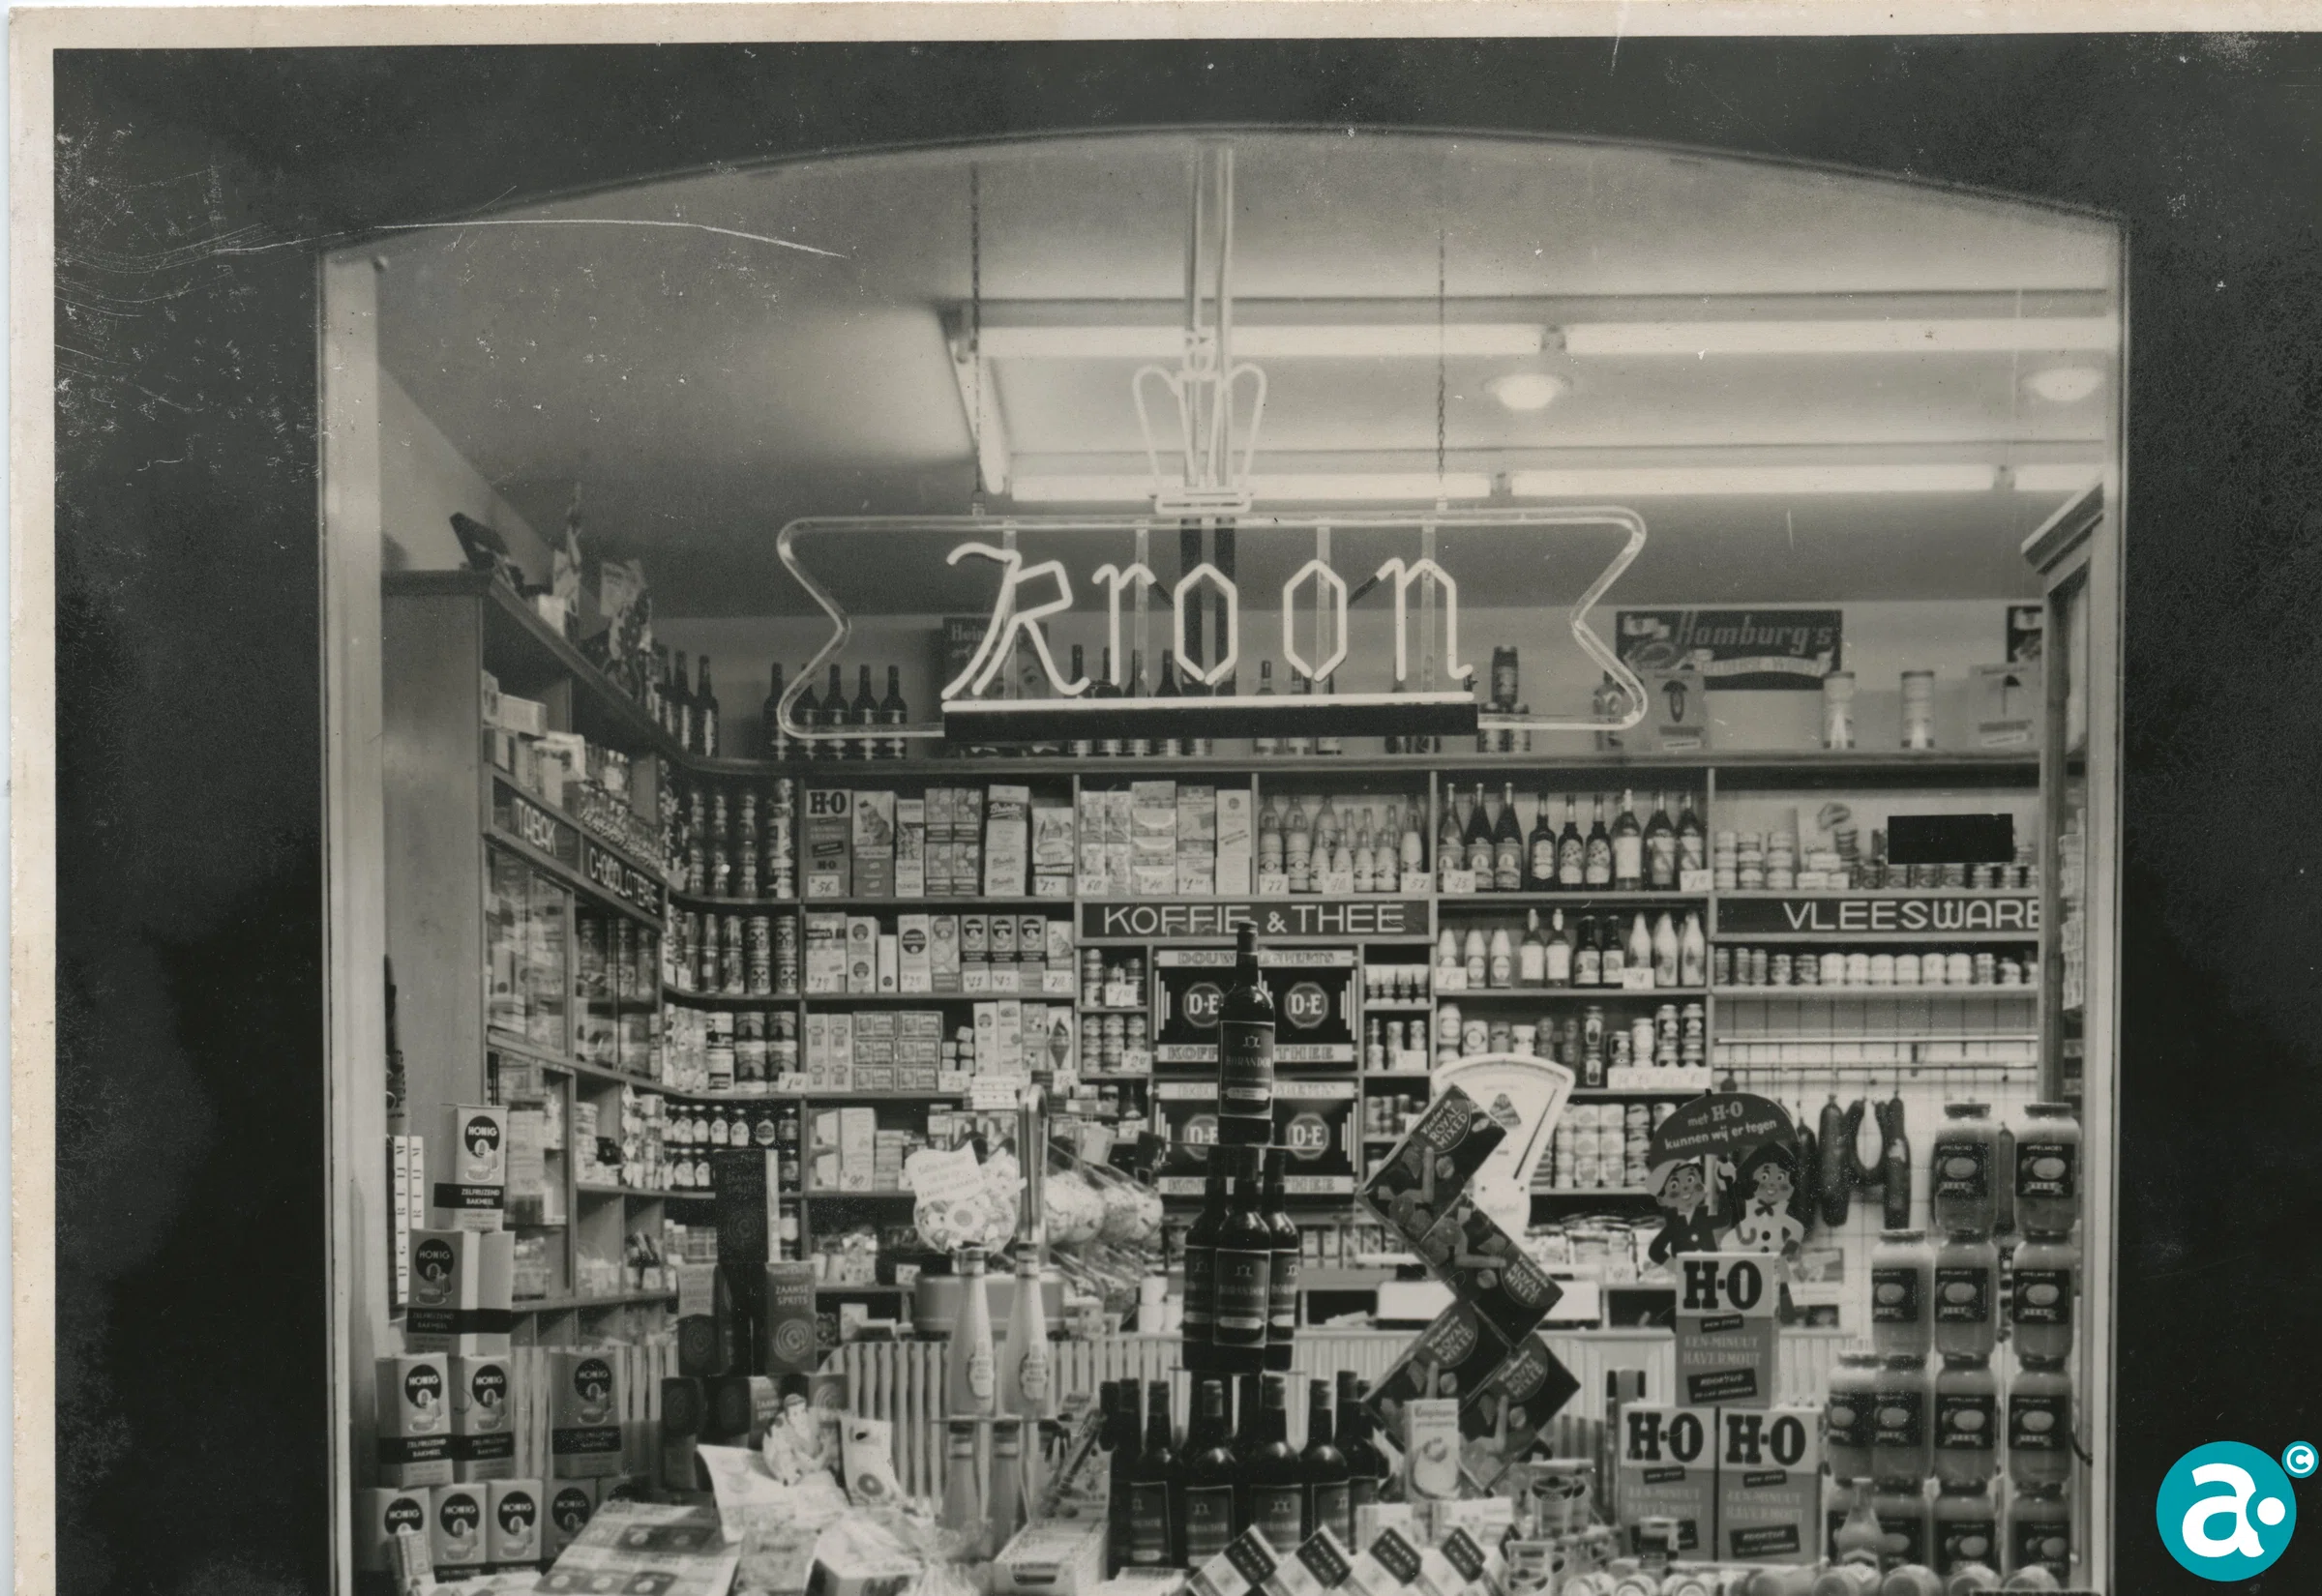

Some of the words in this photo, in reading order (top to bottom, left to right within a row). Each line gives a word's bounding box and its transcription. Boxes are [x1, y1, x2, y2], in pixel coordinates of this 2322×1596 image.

[940, 543, 1474, 699] Kroon
[1677, 610, 1832, 655] Hamburg's
[1104, 904, 1251, 934] KOFFIE
[1266, 911, 1288, 933] &
[1291, 904, 1405, 933] THEE
[1177, 952, 1237, 965] DOUW
[1429, 1108, 1462, 1142] ROYAL
[1686, 1114, 1710, 1127] met
[467, 1126, 497, 1137] HONIG
[1437, 1113, 1469, 1149] MIXED
[1664, 1133, 1710, 1150] kunnen
[1732, 1126, 1743, 1138] er
[1745, 1119, 1777, 1136] tegen
[419, 1251, 450, 1259] HONIG
[776, 1285, 810, 1295] ZAANSE
[408, 1375, 439, 1387] HONIG
[475, 1375, 503, 1386] HONIG
[389, 1509, 420, 1520] HONIG
[445, 1505, 476, 1516] HONIG
[502, 1503, 532, 1514] HONIG
